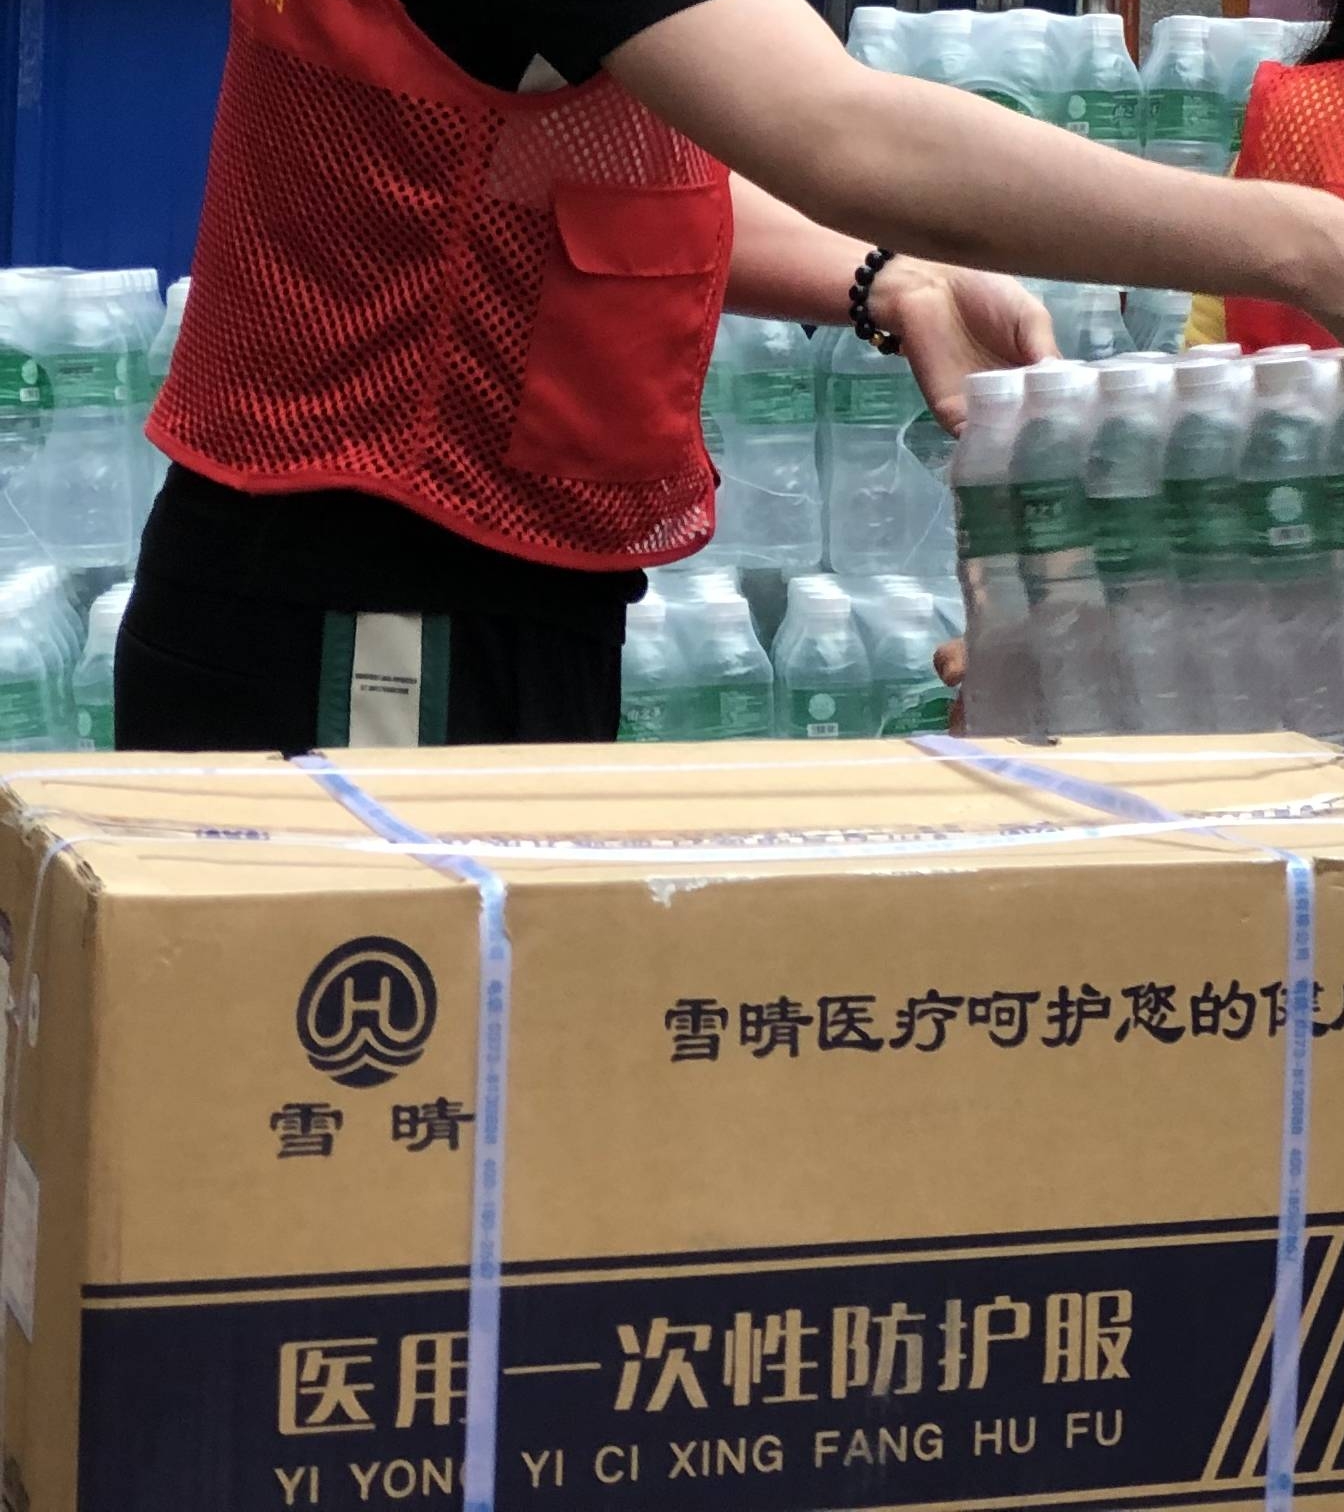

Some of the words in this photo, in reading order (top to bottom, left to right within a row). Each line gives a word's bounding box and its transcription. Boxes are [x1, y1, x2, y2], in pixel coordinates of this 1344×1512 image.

[270, 1097, 477, 1159] 雪晴
[278, 1289, 1134, 1437] 医用一次性防护服
[275, 1463, 320, 1505] YI
[354, 1454, 472, 1500] YON
[522, 1449, 564, 1489] YI
[594, 1444, 640, 1485] CI
[670, 1435, 785, 1479] XING
[815, 1422, 944, 1469] FANG
[973, 1417, 1037, 1457] HU
[1067, 1409, 1125, 1449] FU
